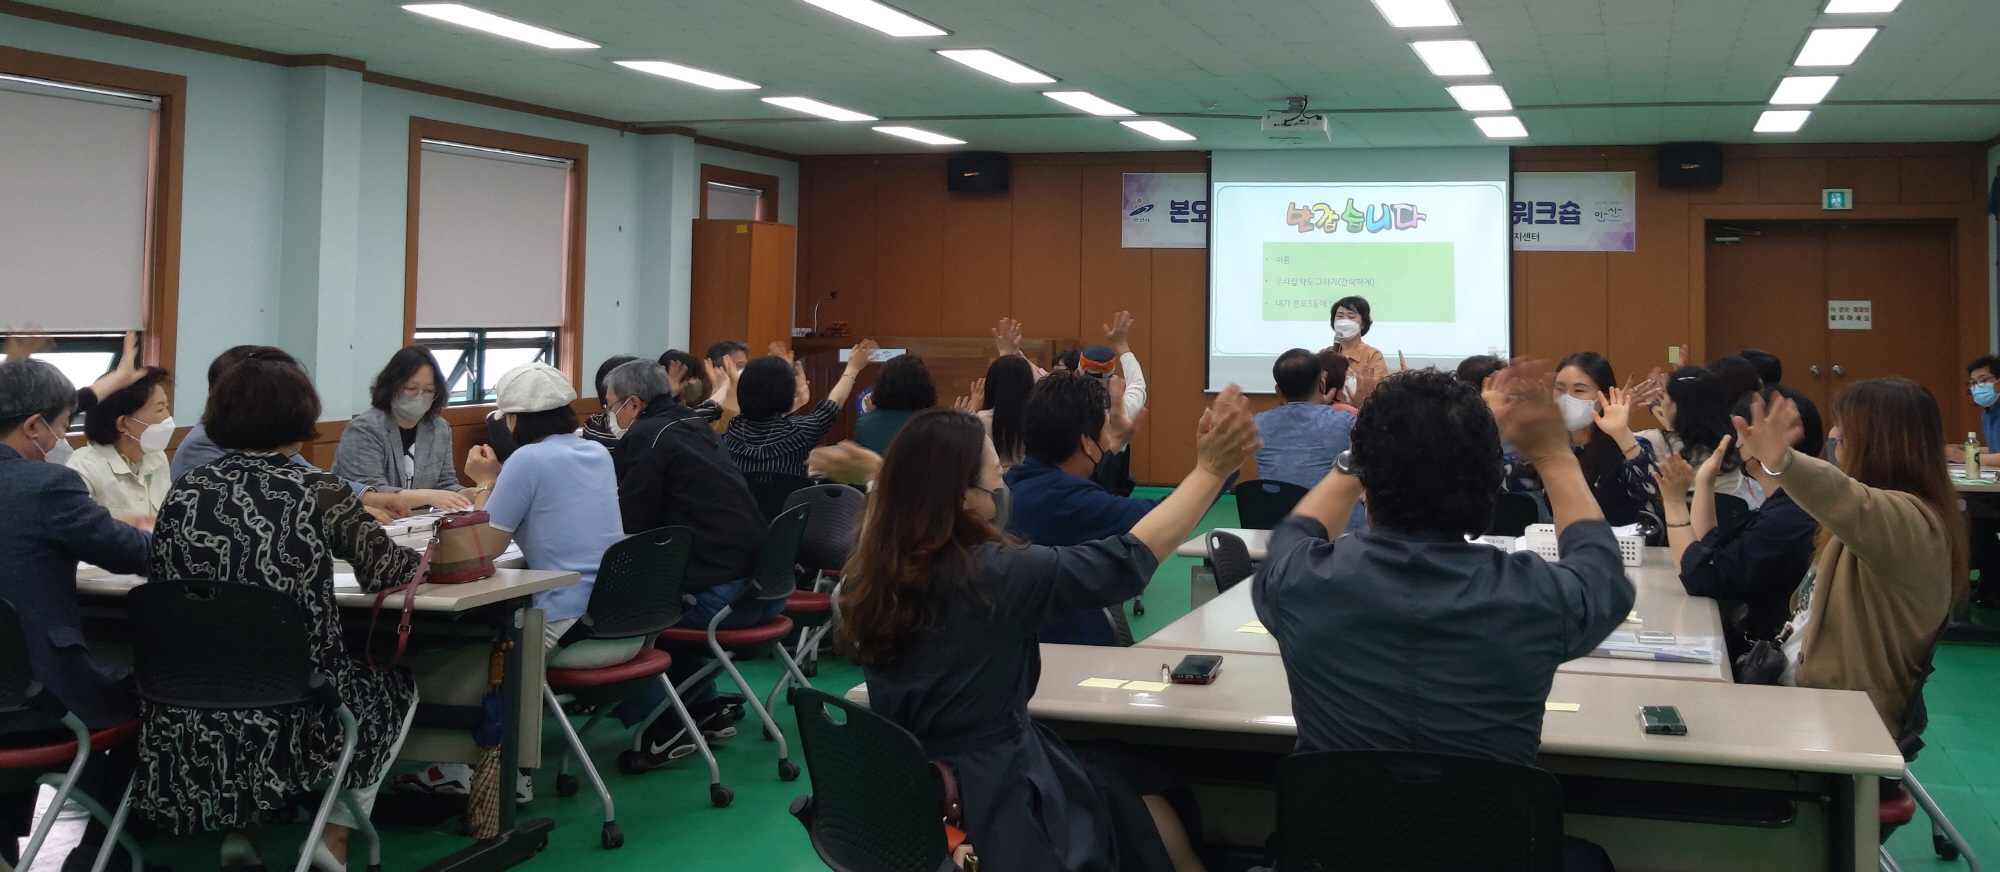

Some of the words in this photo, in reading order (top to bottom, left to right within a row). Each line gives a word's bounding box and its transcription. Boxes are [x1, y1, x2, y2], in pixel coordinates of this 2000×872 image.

[1286, 197, 1427, 234] 반갑습니다
[1513, 200, 1581, 225] 워크숍
[1275, 255, 1290, 265] 이름
[1275, 277, 1298, 287] 우리집
[1299, 277, 1314, 287] 약도
[1275, 299, 1291, 308] 내가
[1293, 299, 1328, 309] 본오3동에
